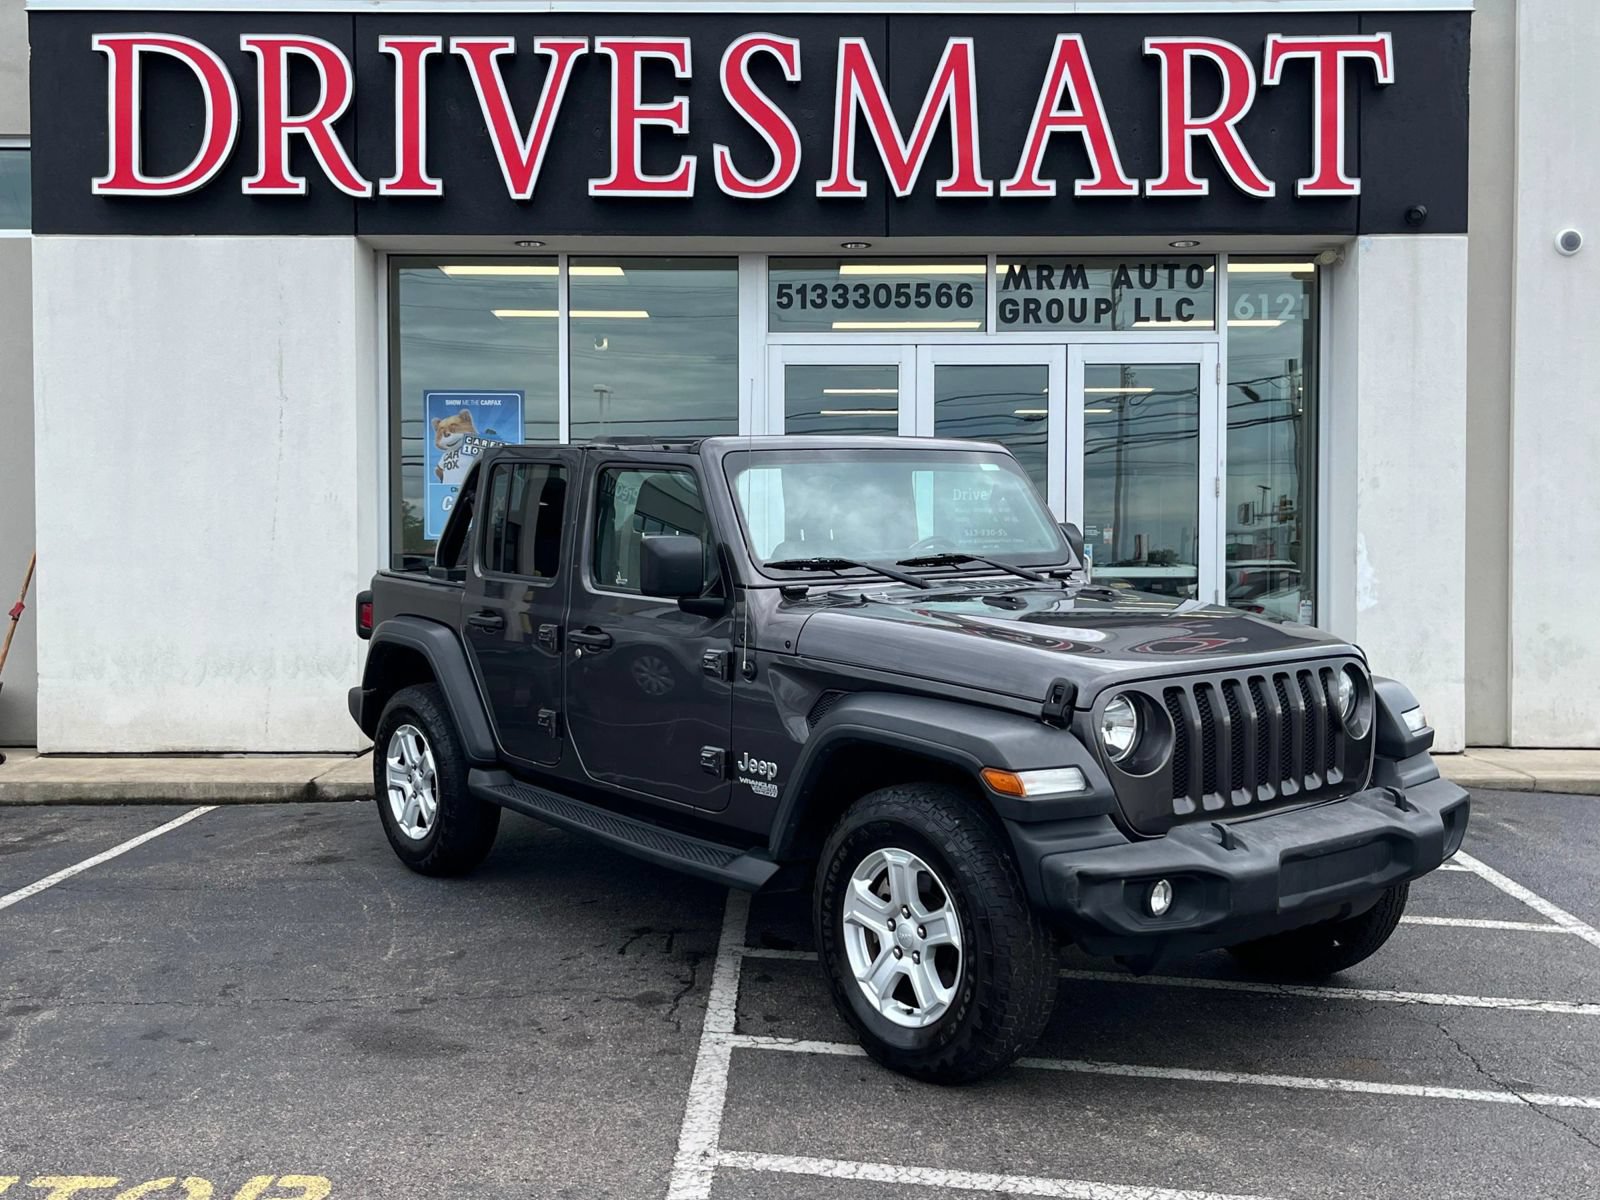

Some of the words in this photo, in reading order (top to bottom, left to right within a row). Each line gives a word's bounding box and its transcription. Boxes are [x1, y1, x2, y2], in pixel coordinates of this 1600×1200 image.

[91, 31, 1395, 200] DRIVESMART
[1001, 263, 1089, 290] MRM
[1114, 263, 1206, 290] AUTO
[776, 282, 974, 310] 5133305566
[1234, 293, 1310, 320] 6121
[998, 297, 1114, 324] GROUP
[1134, 297, 1196, 323] LLC
[737, 752, 778, 781] Jeep
